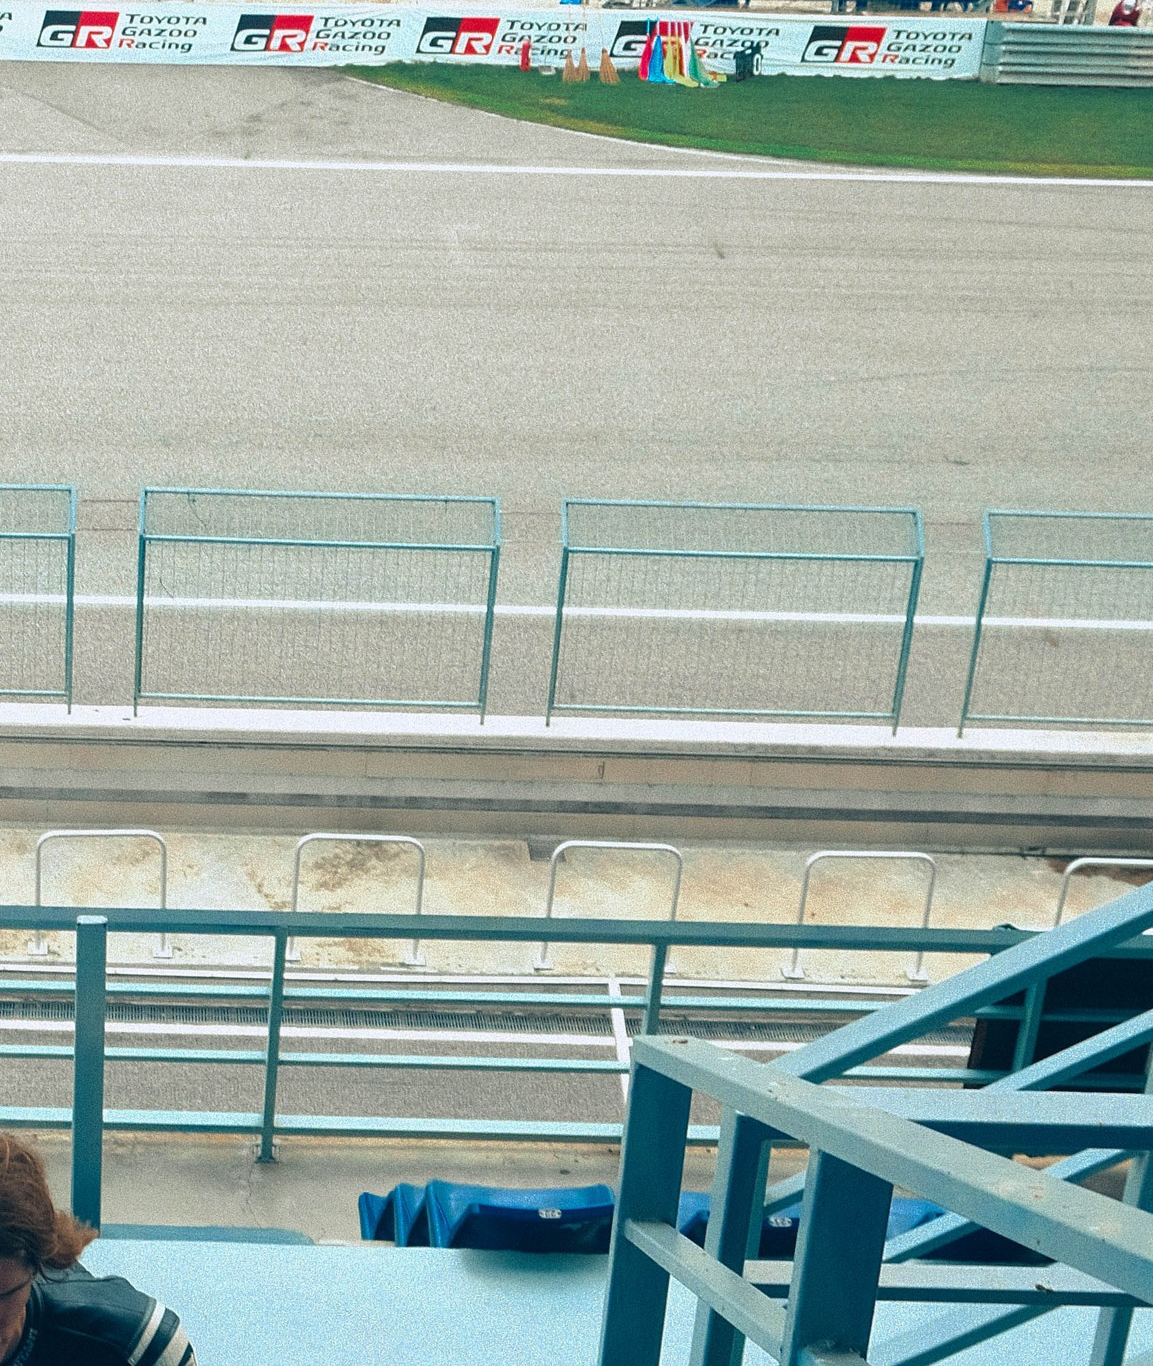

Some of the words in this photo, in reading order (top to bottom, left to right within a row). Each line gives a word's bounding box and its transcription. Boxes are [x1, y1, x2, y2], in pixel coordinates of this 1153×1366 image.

[125, 13, 207, 26] TOYOTA
[320, 16, 401, 28] TOYOTA
[507, 20, 587, 32] TOYOTA
[38, 24, 115, 49] GR
[121, 26, 197, 38] GAZOO
[315, 28, 392, 40] GAZOO
[700, 24, 780, 37] TOYOTA
[893, 30, 972, 42] TOYOTA
[118, 39, 193, 53] Racing
[231, 28, 309, 52] GR
[416, 31, 497, 55] GR
[312, 41, 386, 55] Racing
[803, 40, 880, 63] GR
[887, 42, 961, 54] GAZOO
[882, 54, 955, 69] Racing
